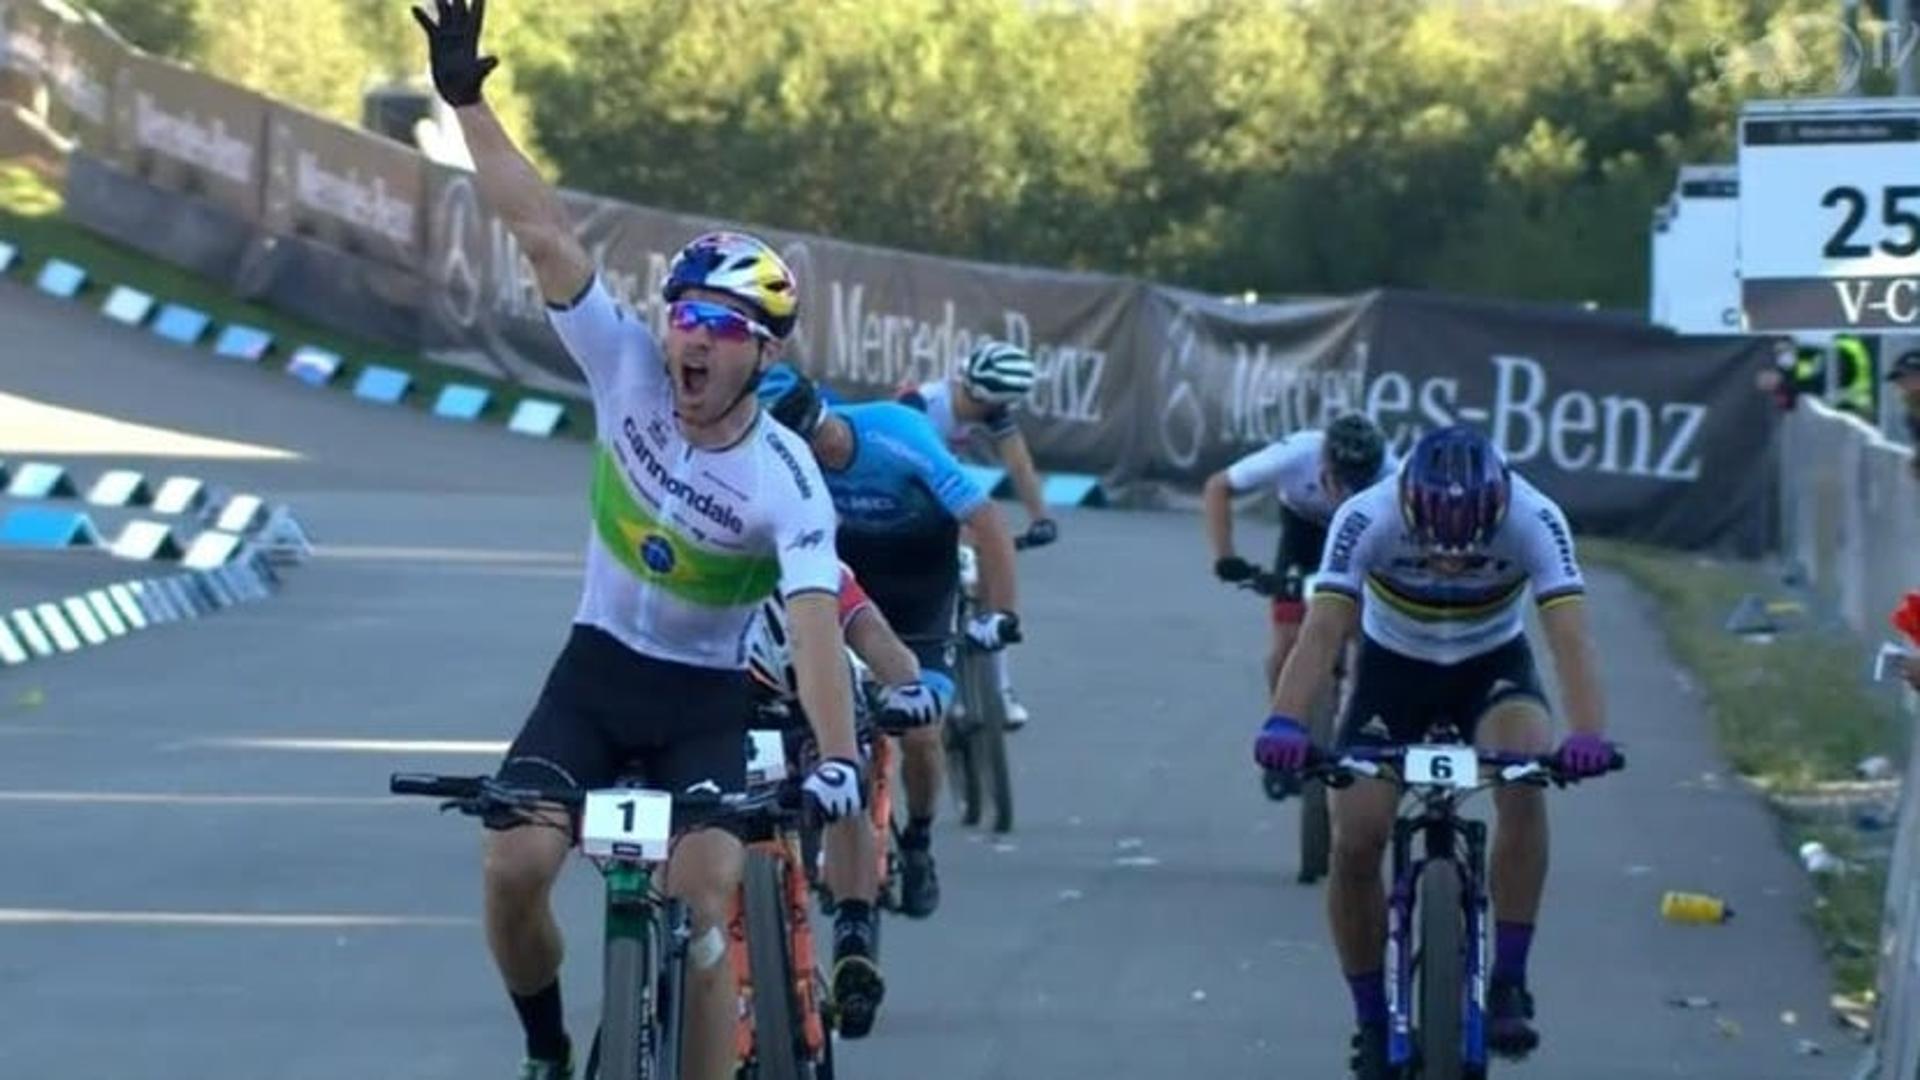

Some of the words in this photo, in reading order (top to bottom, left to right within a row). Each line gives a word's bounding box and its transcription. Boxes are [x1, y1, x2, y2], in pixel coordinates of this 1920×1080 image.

[622, 415, 745, 536] cannondale
[1430, 754, 1453, 780] 6
[616, 800, 636, 833] 1
